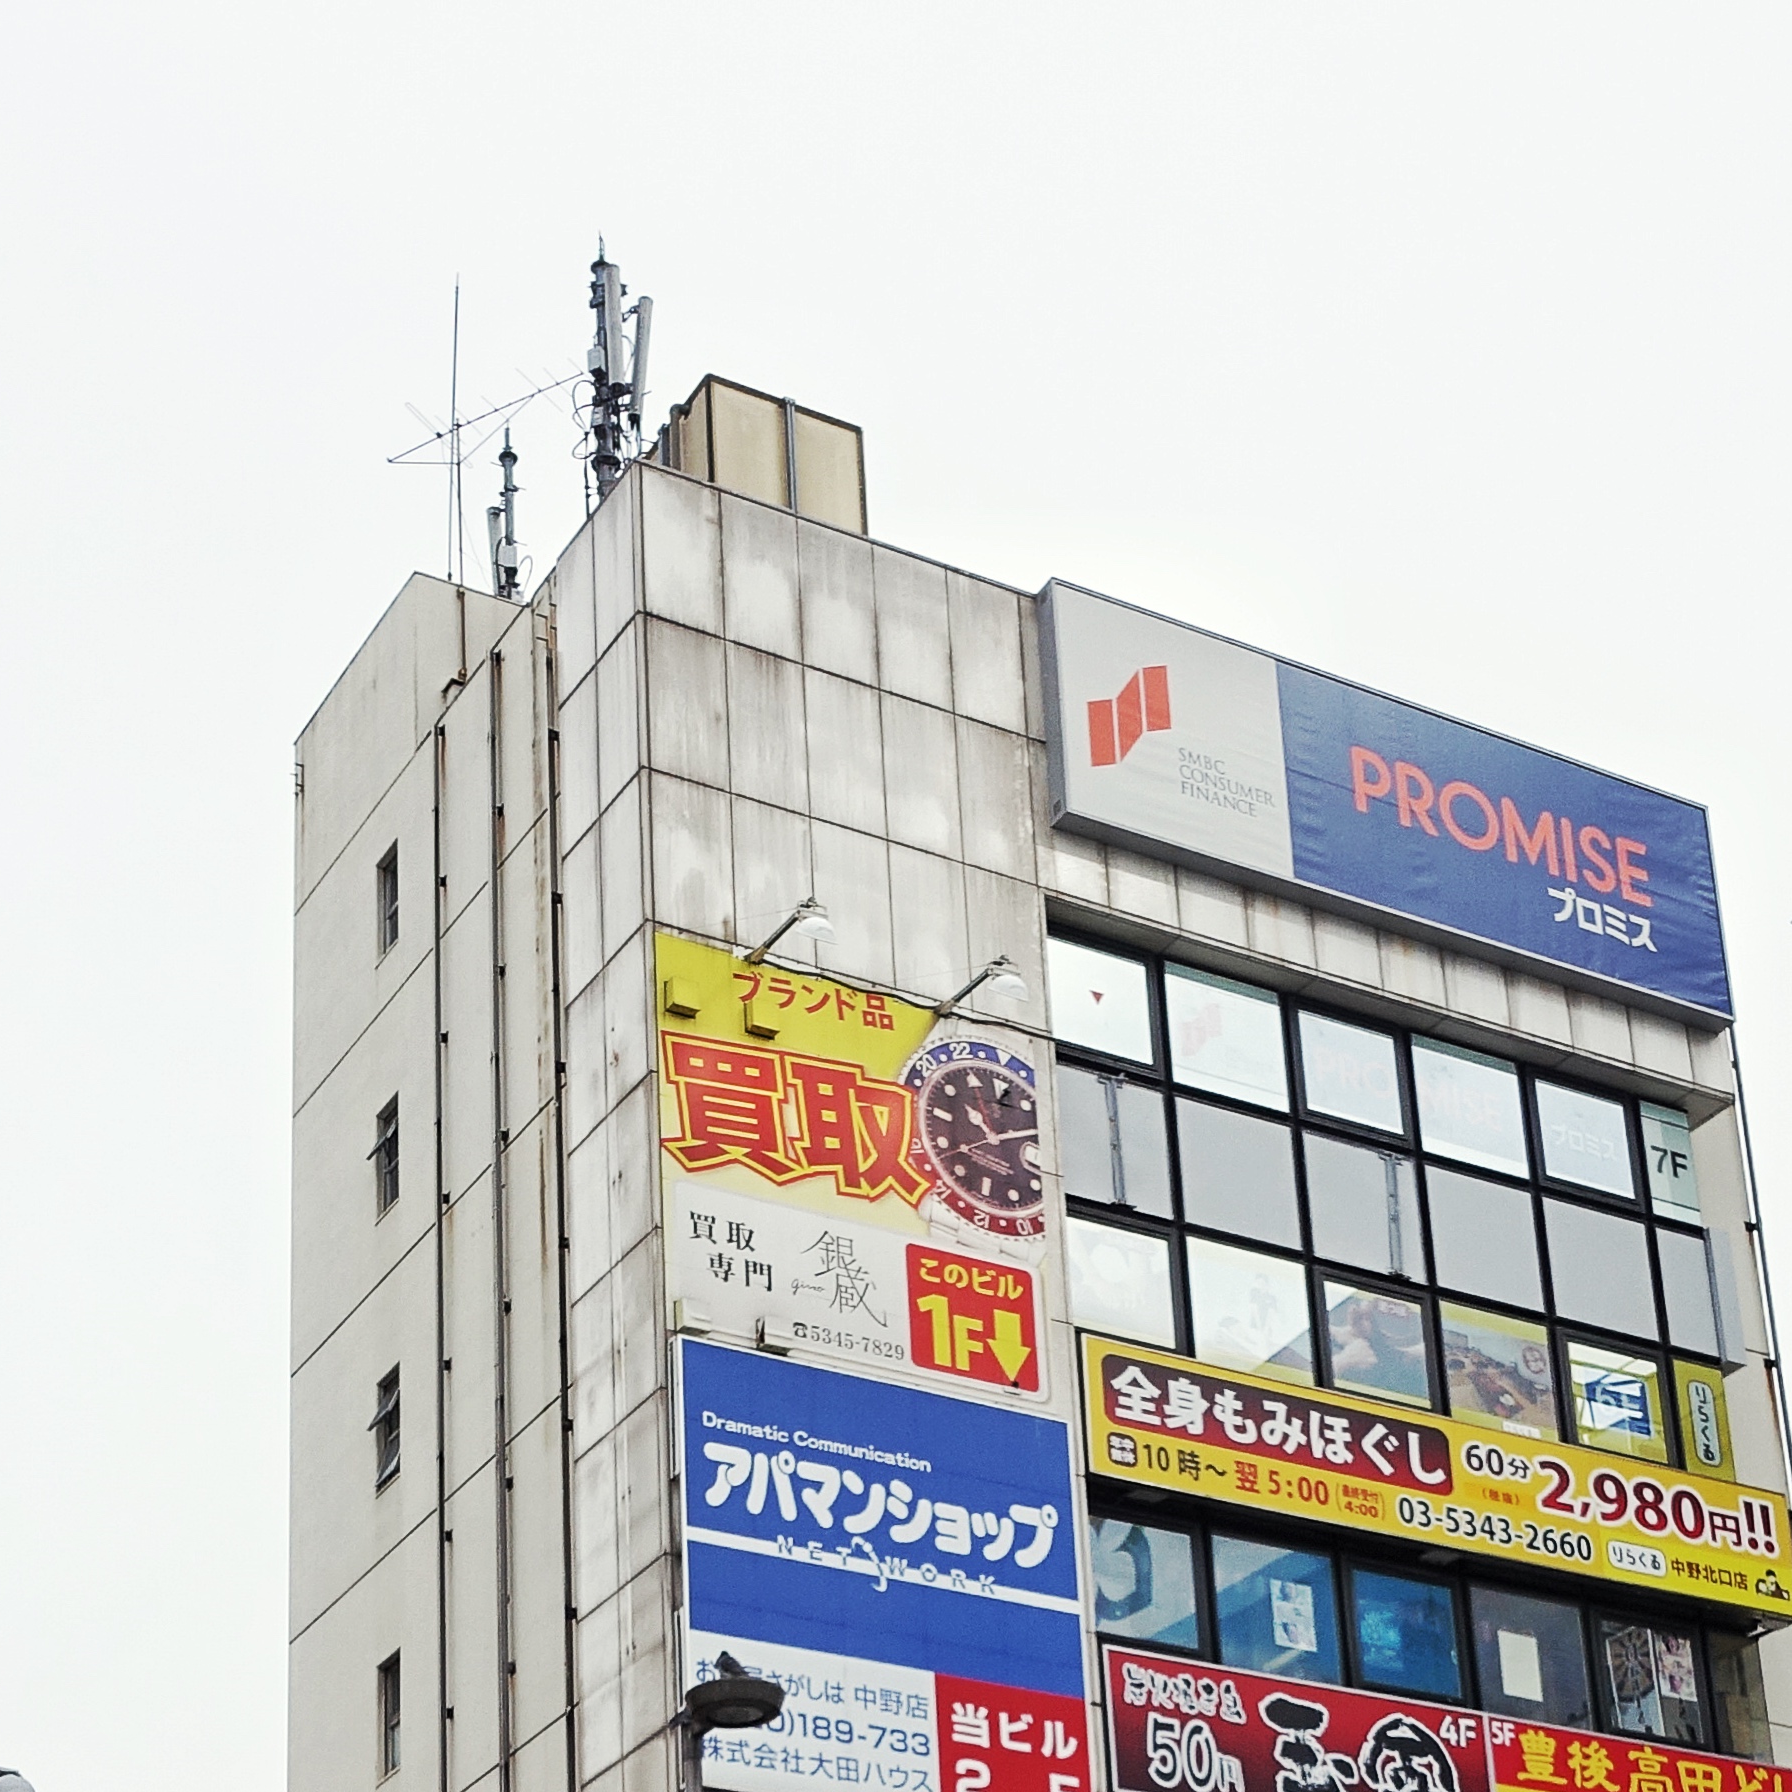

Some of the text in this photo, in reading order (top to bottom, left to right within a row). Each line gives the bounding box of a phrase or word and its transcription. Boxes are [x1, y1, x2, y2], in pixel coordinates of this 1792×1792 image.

[1178, 747, 1226, 775] SMBC
[1180, 764, 1275, 808] CONSUMER
[1180, 780, 1258, 818] FINANCE
[1350, 745, 1653, 907] PROMISE
[1546, 887, 1659, 953] プロミス
[732, 970, 895, 1030] ブランド品
[660, 1030, 932, 1207] 買取
[1648, 1144, 1691, 1181] 7F
[689, 1210, 756, 1252] 買取
[708, 1252, 774, 1293] 専門
[801, 1230, 889, 1327] 銀蔵
[919, 1256, 1024, 1300] このビル
[917, 1294, 985, 1372] 1F
[701, 1410, 932, 1473] Dramatic Communication
[1110, 1364, 1448, 1486] 全身もみほぐし
[1464, 1443, 1530, 1480] 60分
[703, 1441, 1060, 1569] アパマンショップ
[1398, 1496, 1593, 1562] 03-5343-2660
[1671, 1557, 1748, 1591] 中野北口店
[855, 1683, 930, 1720] 中野店
[951, 1702, 1079, 1759] 当ビル
[1439, 1715, 1477, 1747] 4F
[1491, 1724, 1515, 1747] 5F
